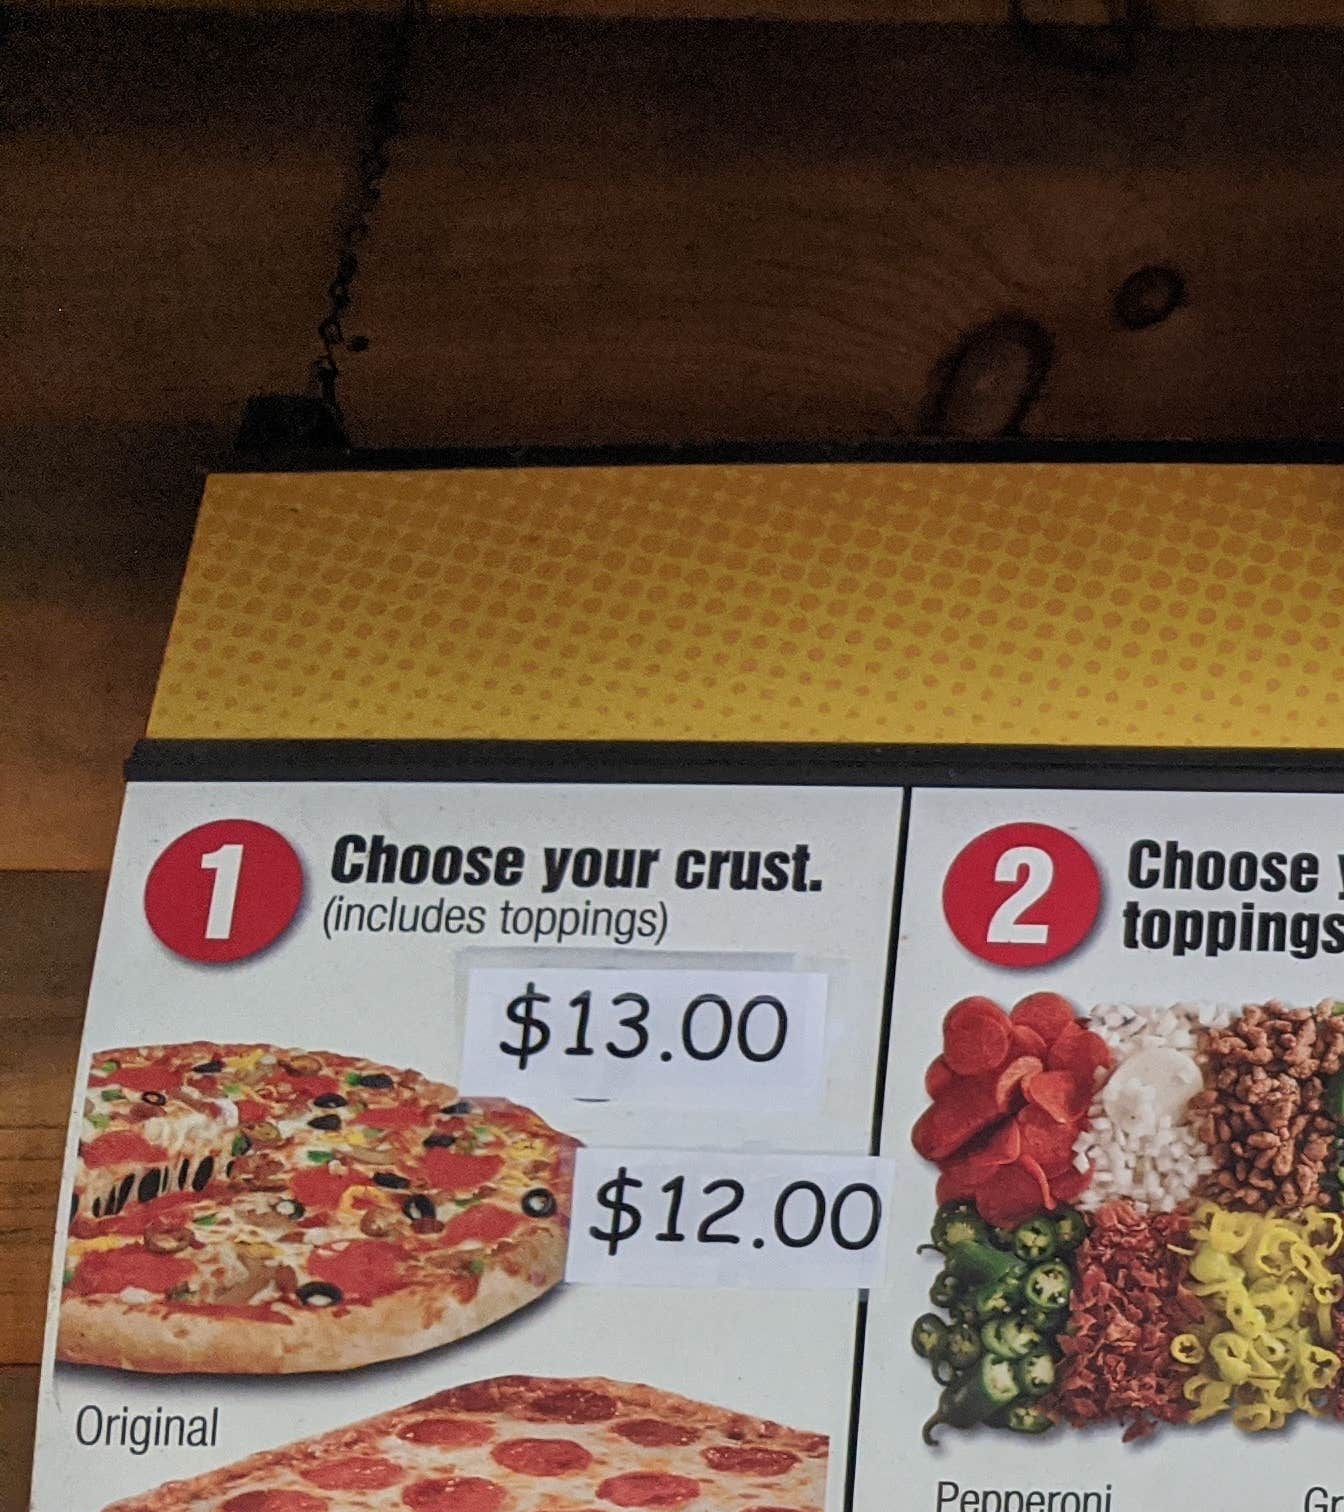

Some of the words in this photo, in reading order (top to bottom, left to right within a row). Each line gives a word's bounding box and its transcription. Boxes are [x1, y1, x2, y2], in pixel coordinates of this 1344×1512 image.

[201, 845, 243, 939] 1
[331, 835, 524, 886] Choose
[542, 848, 660, 893] your
[675, 845, 822, 892] crust.
[987, 847, 1053, 944] 2
[1128, 840, 1319, 893] Choose
[324, 895, 486, 939] (includes
[501, 900, 667, 945] toppings)
[500, 982, 787, 1070] $13.00
[590, 1167, 881, 1256] $12.00
[77, 1405, 218, 1455] Original
